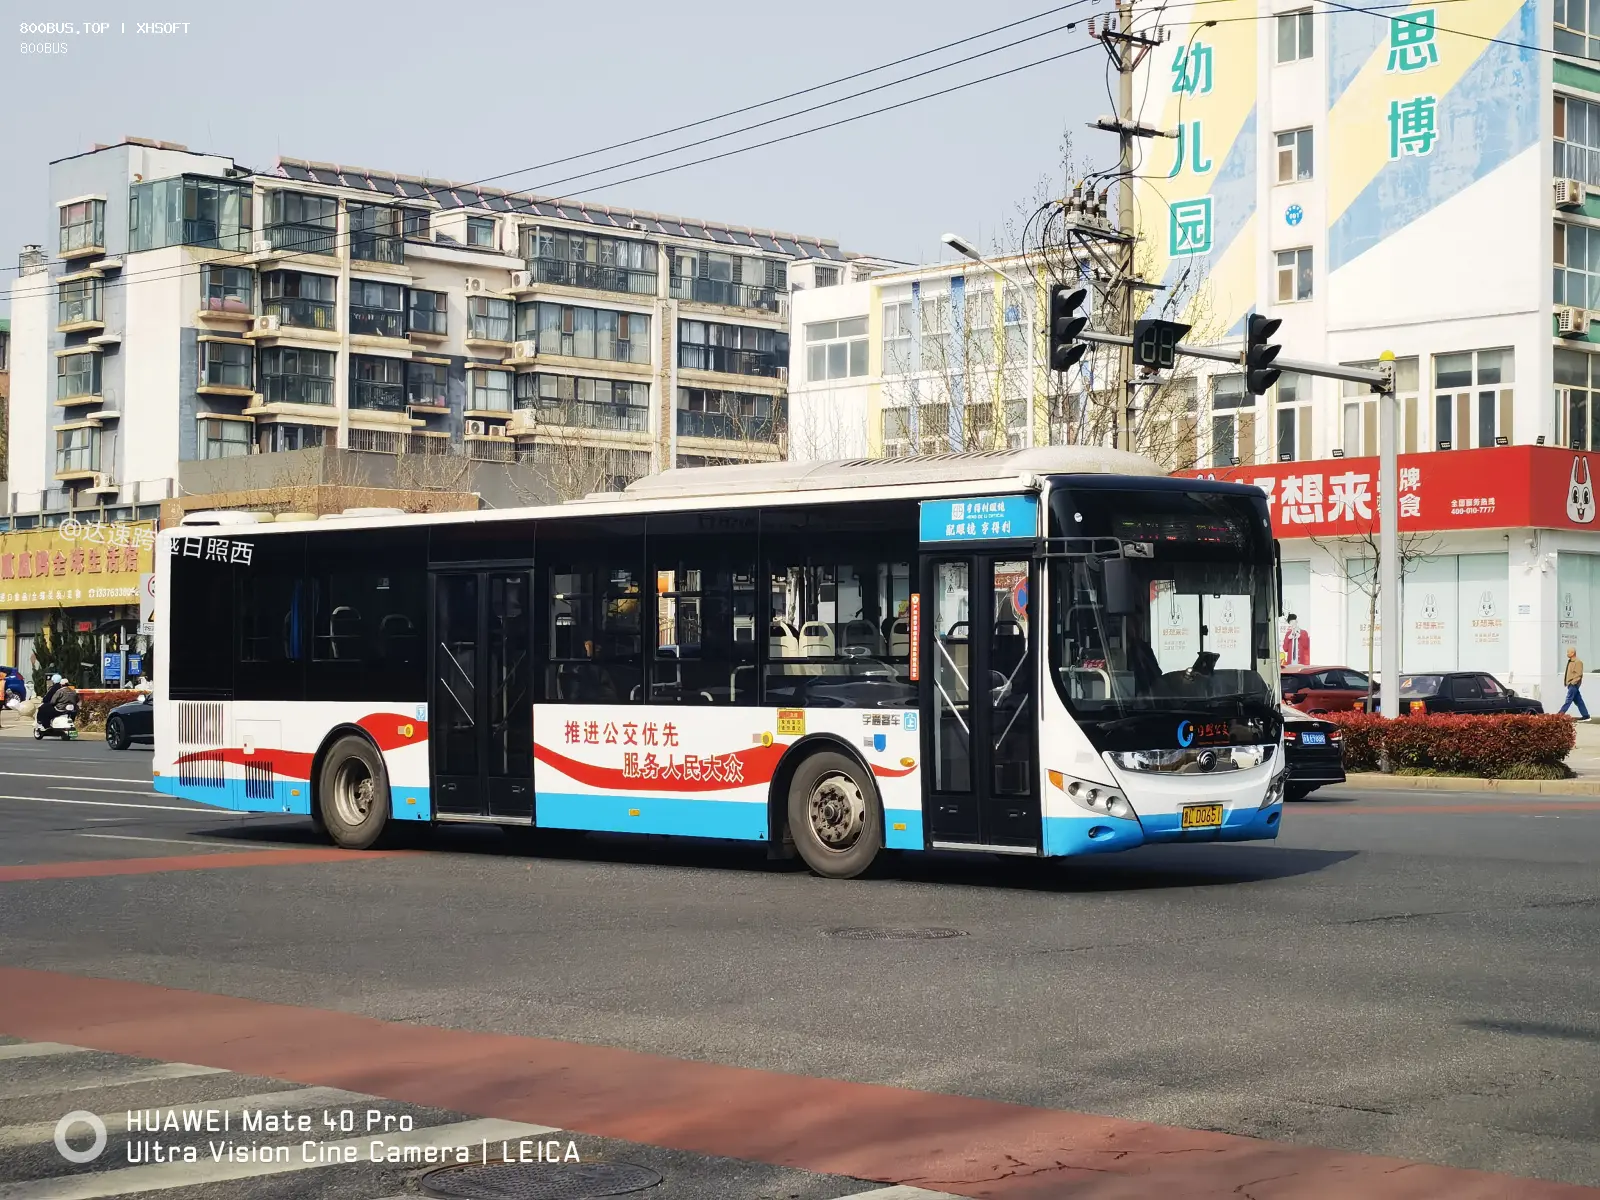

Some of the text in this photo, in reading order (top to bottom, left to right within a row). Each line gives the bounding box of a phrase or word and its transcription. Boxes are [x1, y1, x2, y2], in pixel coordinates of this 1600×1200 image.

[1387, 10, 1438, 159] 思博
[1169, 42, 1213, 256] 幼儿园
[1450, 505, 1496, 515] 400-010-7777
[945, 520, 1011, 536] 配眼镜 亨得利
[564, 720, 680, 747] 推进公交优先
[622, 752, 745, 784] 服务人民大众
